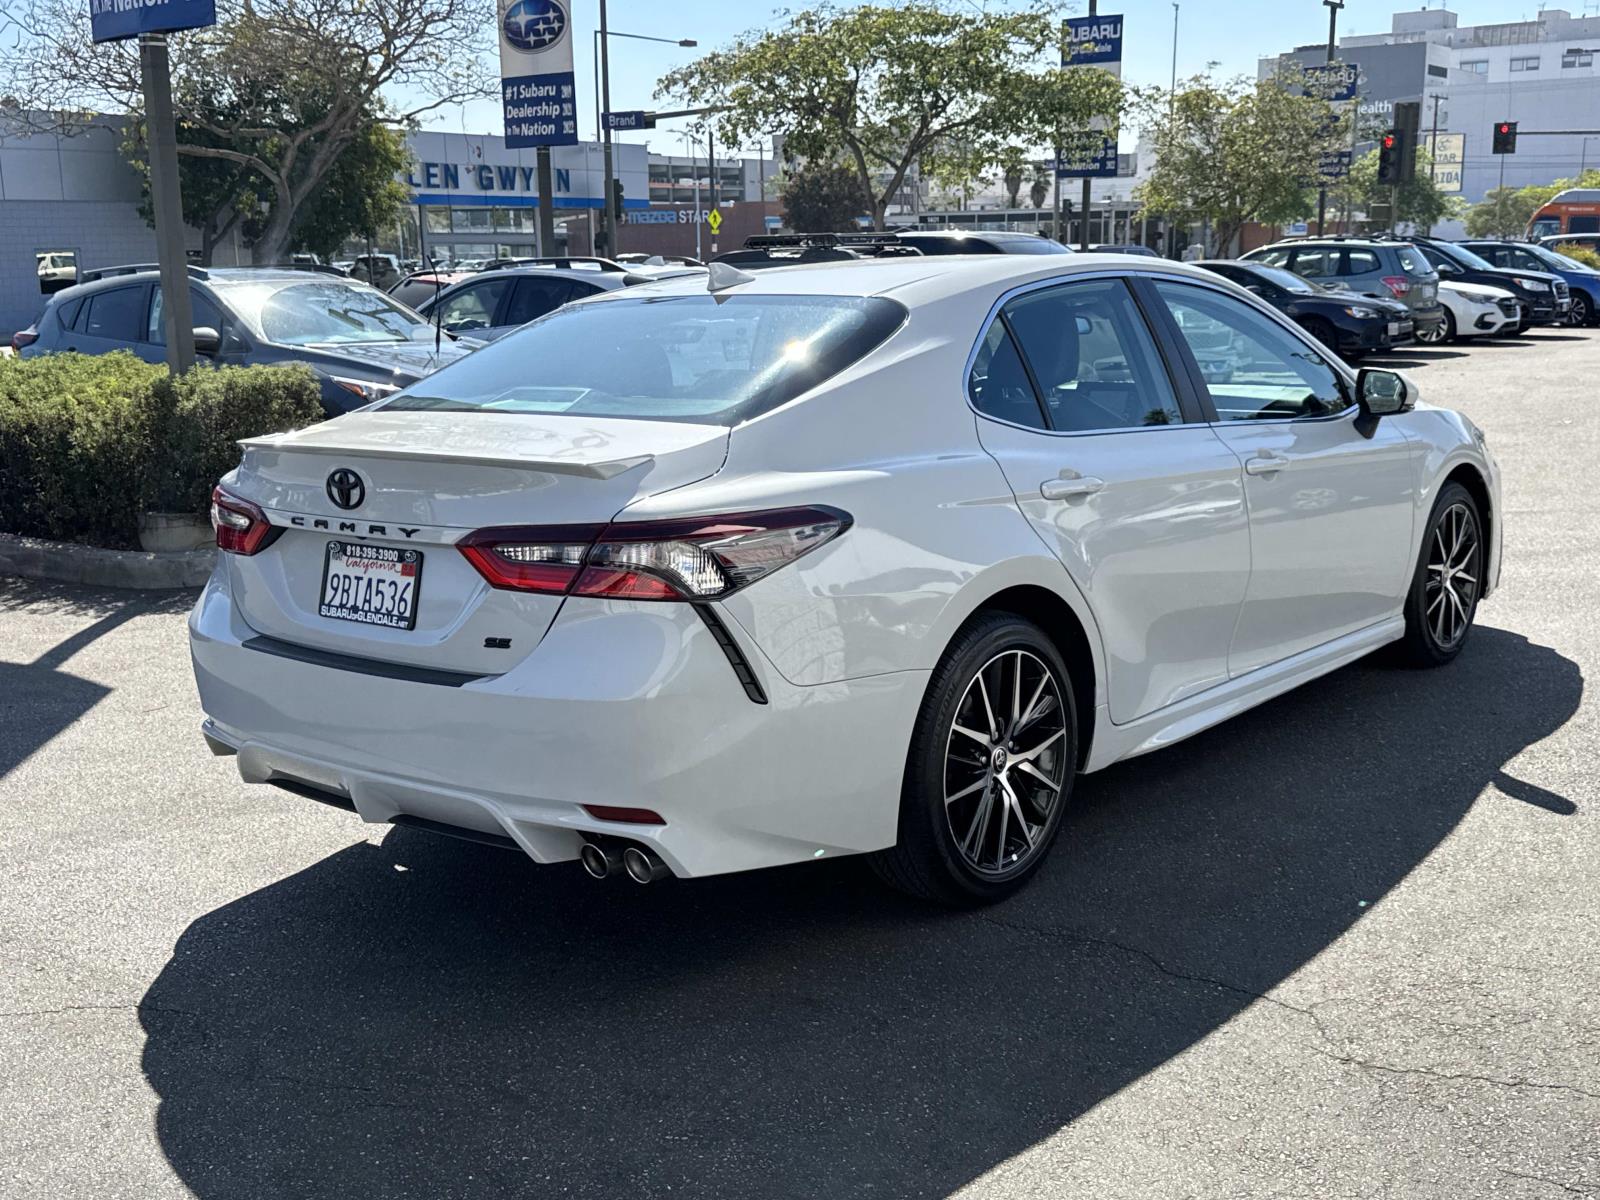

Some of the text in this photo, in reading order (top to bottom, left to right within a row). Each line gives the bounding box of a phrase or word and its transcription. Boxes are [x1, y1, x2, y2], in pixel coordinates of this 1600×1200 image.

[114, 0, 169, 13] Nat
[505, 83, 557, 100] #1 Subaru
[506, 101, 561, 119] Dealership
[608, 114, 636, 127] Brand
[521, 121, 556, 137] Nation
[407, 162, 570, 193] LEN GWYN
[679, 210, 710, 224] STAR
[291, 516, 421, 538] CAMRY
[346, 545, 399, 561] 818-396-3900
[345, 559, 402, 574] California
[327, 573, 411, 616] 9BIA536
[483, 636, 513, 649] SE
